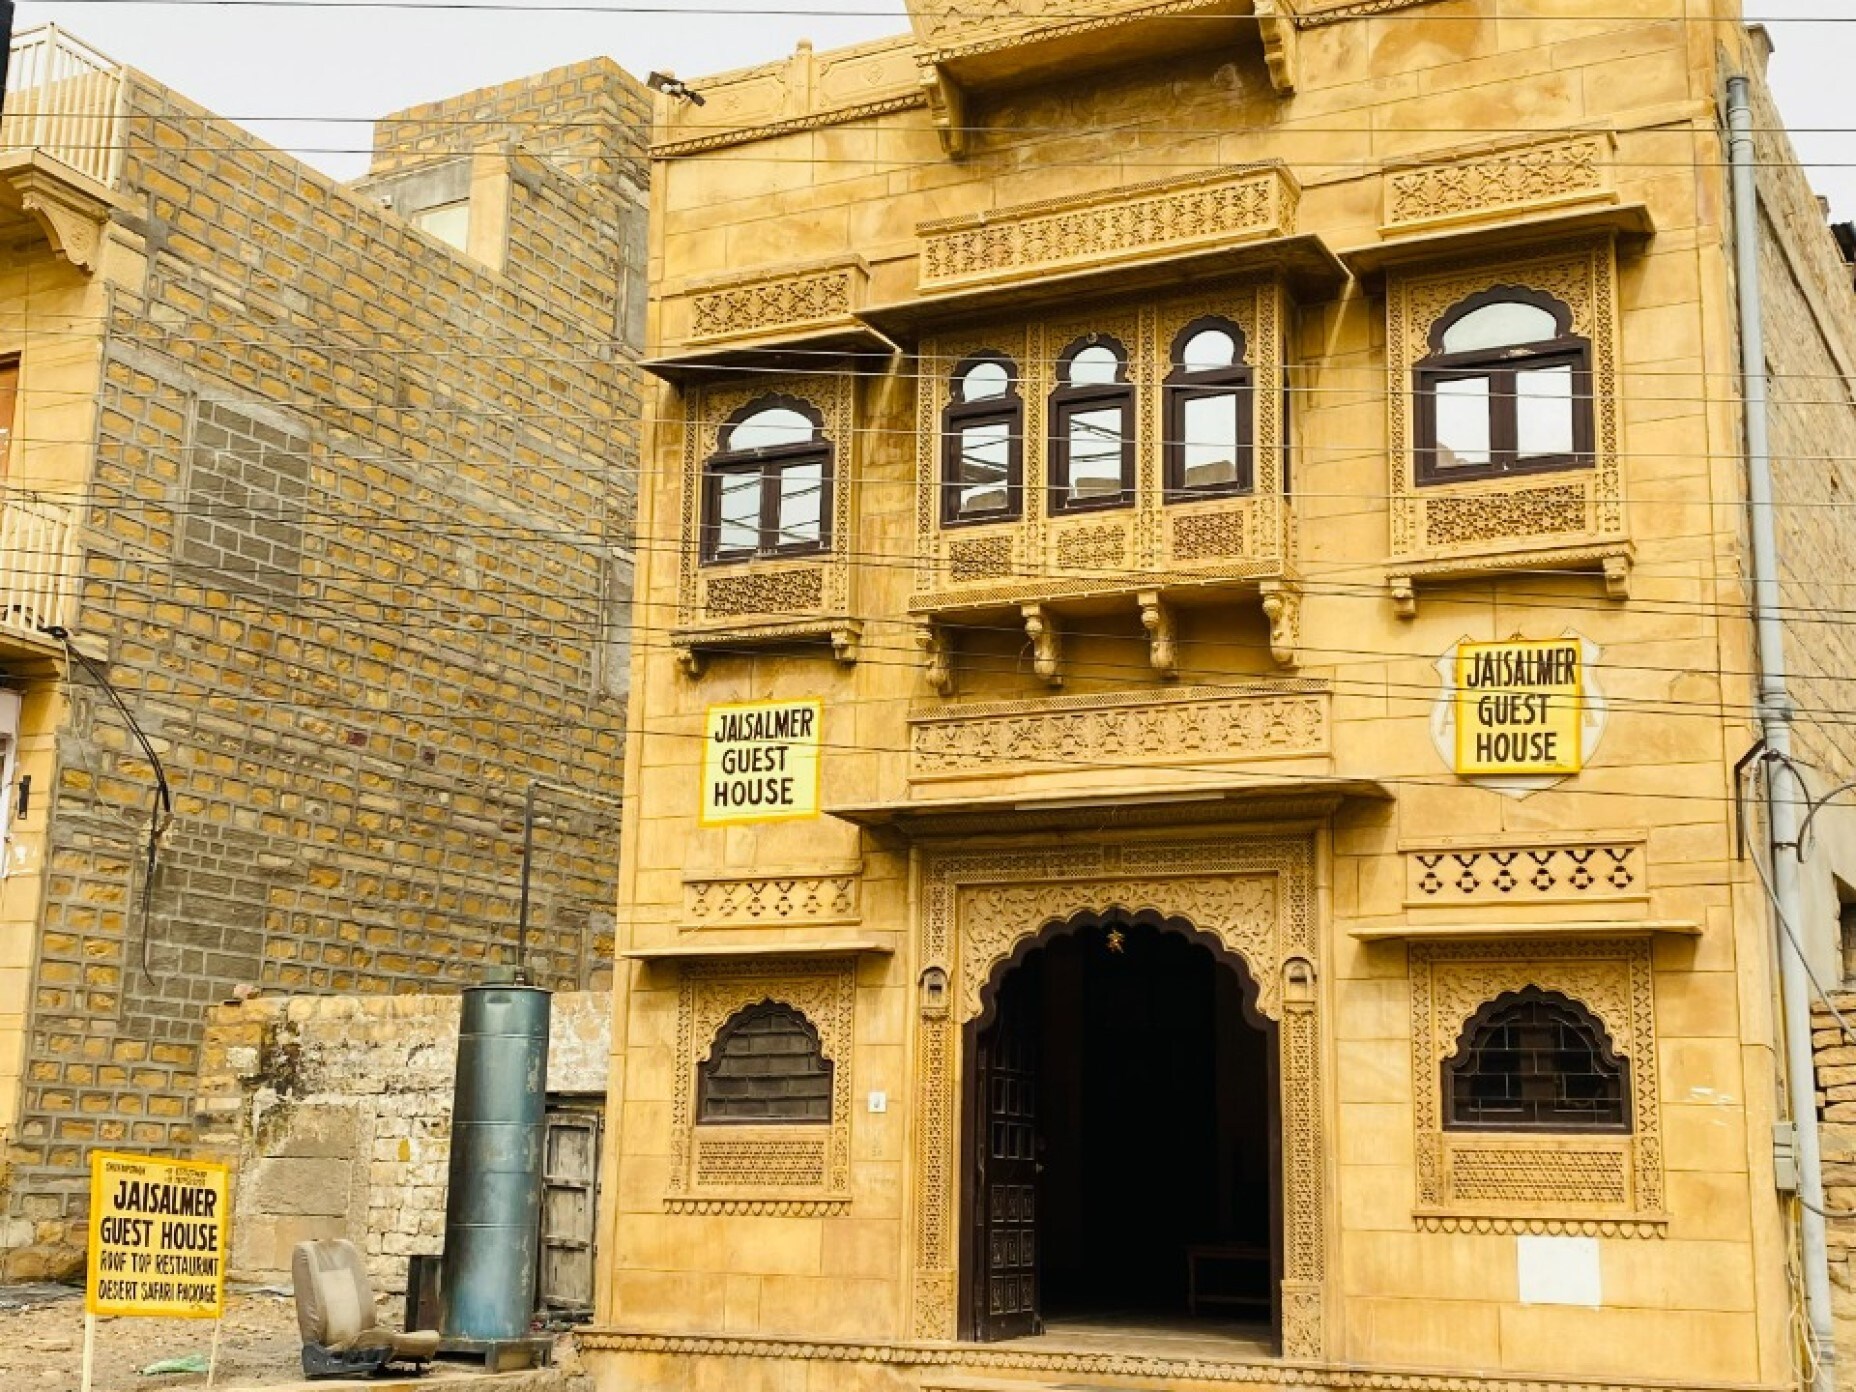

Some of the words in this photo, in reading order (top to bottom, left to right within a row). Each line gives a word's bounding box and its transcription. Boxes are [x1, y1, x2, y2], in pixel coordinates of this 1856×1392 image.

[1467, 648, 1576, 687] JAISALMER
[715, 708, 814, 742] JAISALMER
[1478, 694, 1550, 727] GUEST
[722, 746, 789, 775] GUEST
[1476, 732, 1557, 762] HOUSE
[714, 777, 794, 806] HOUSE
[114, 1180, 217, 1217] JAISALMER
[101, 1216, 153, 1247] GUEST
[160, 1221, 217, 1251] HOUSE
[101, 1251, 126, 1272] ROOF
[131, 1252, 151, 1273] TOP
[156, 1254, 219, 1276] RESTAURANT
[99, 1279, 138, 1300] DESERT
[141, 1281, 175, 1302] SAFARI
[178, 1283, 216, 1303] PACKAGE
